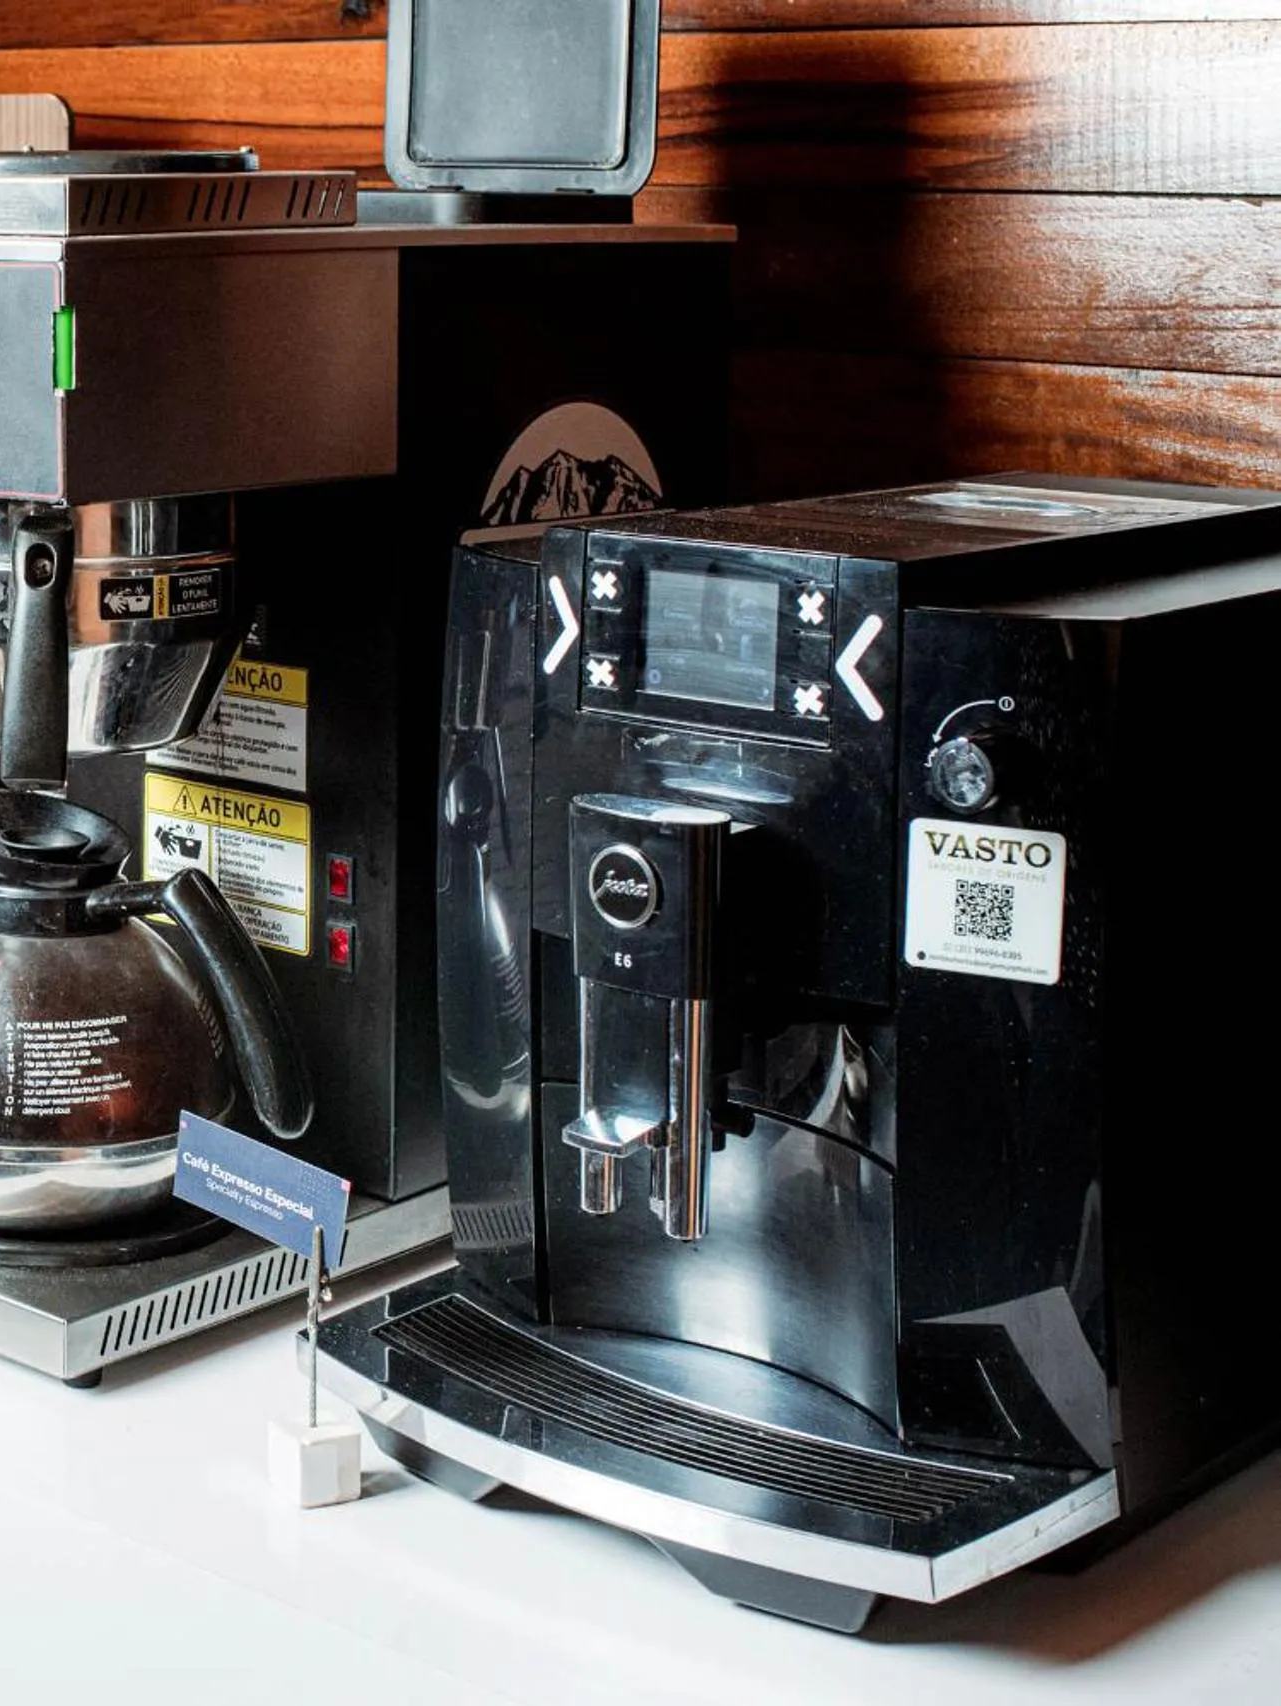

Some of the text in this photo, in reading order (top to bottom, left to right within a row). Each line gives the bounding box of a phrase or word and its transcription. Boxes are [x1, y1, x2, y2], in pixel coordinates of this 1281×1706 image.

[171, 599, 218, 613] LENTAMENTE
[200, 794, 281, 828] ATENÇÃO
[925, 830, 1052, 868] VASTO
[614, 951, 633, 969] E6
[54, 1020, 70, 1029] PAS
[182, 1151, 315, 1220] Café Expresso Especial
[205, 1177, 245, 1205] Specialty
